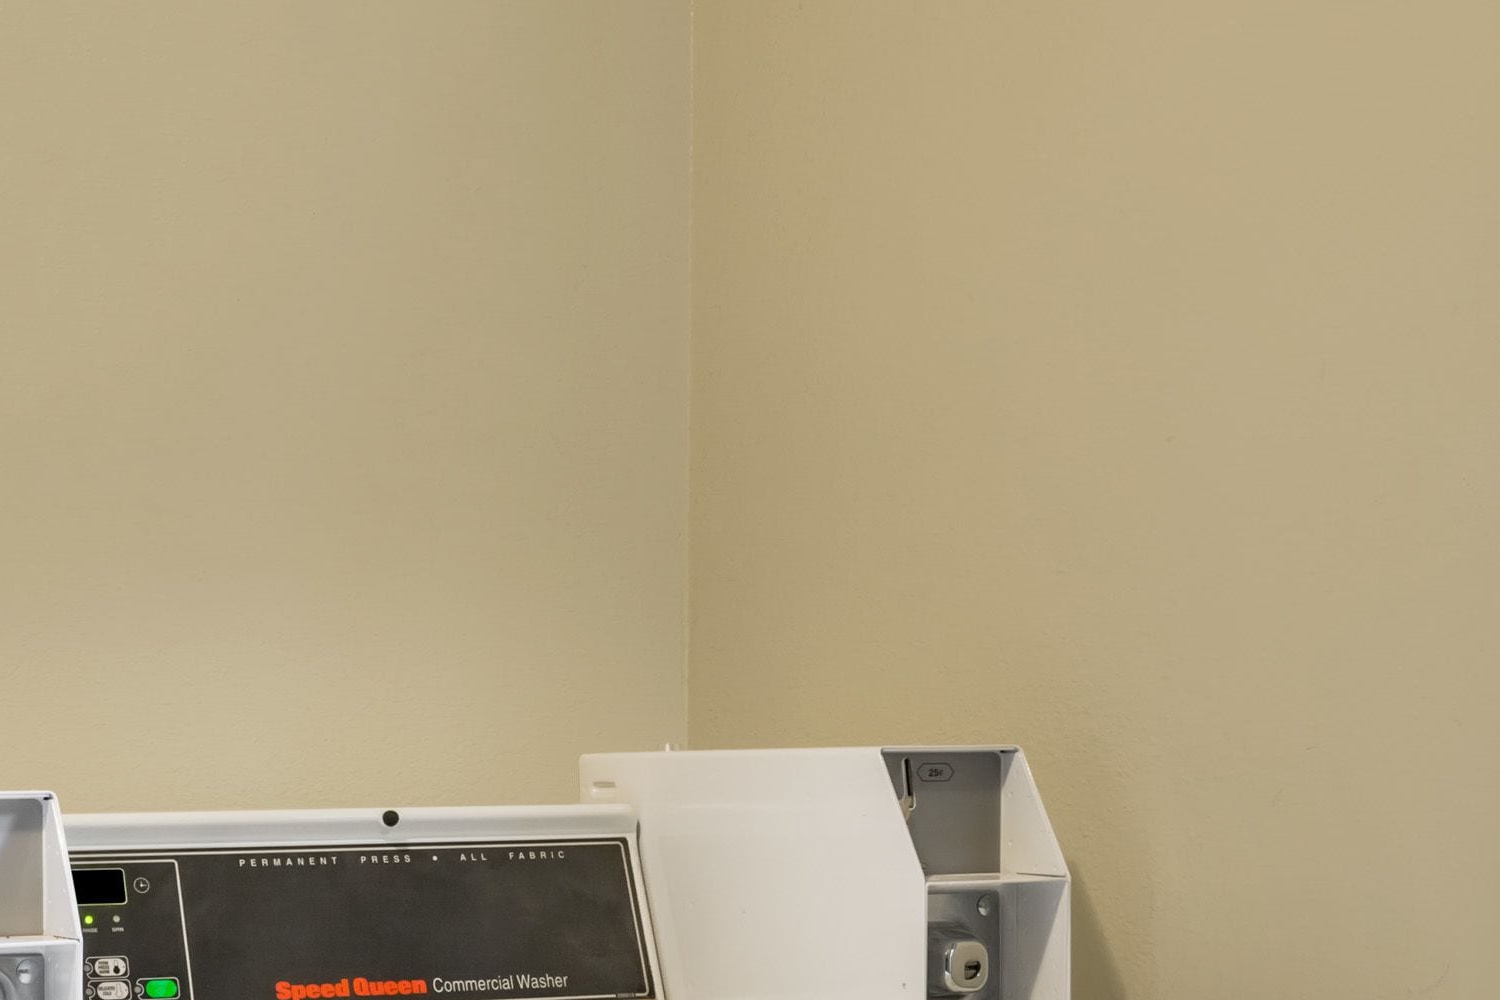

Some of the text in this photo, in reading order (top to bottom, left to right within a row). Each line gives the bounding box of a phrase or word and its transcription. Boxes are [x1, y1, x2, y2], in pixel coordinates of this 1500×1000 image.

[239, 850, 567, 867] PERMANENT PRESS ALL FABRIC
[352, 977, 428, 998] Queen
[432, 975, 514, 993] Commercial
[516, 974, 569, 989] Washer
